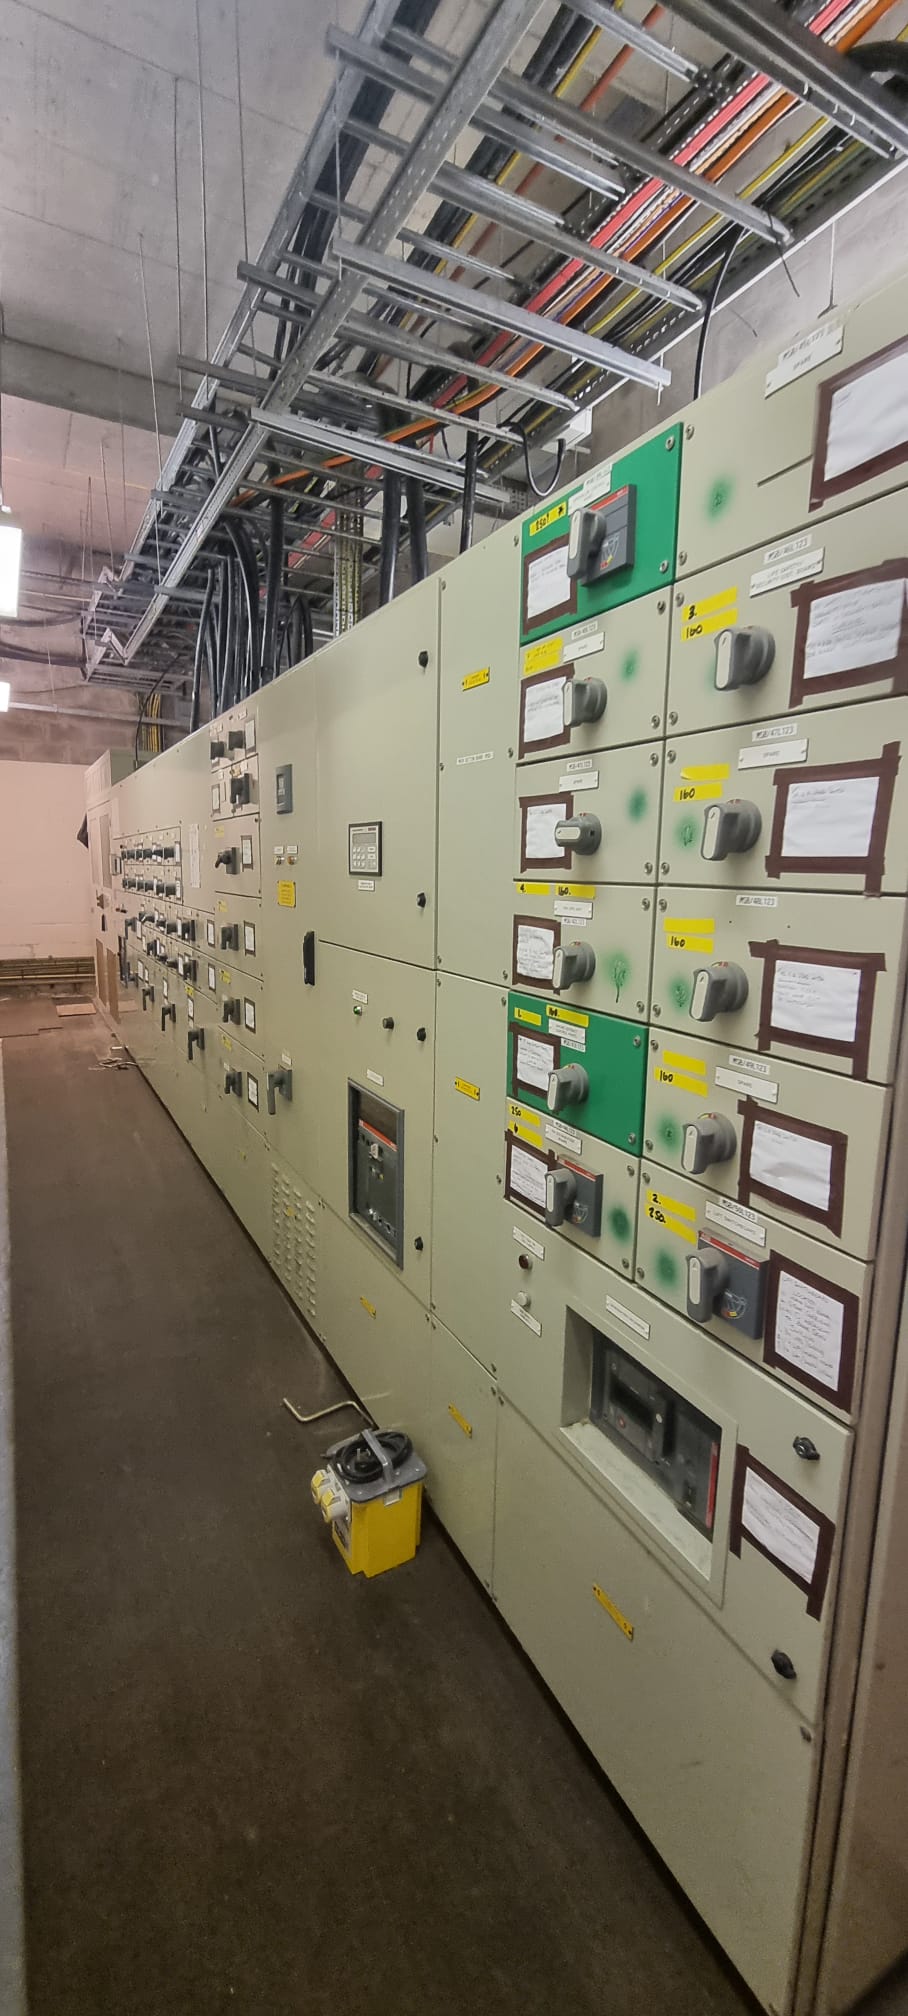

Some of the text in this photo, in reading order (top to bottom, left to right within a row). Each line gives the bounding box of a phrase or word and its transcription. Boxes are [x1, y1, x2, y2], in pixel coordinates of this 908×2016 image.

[679, 788, 696, 801] 160
[670, 935, 686, 948] 160
[659, 1070, 674, 1082] 160
